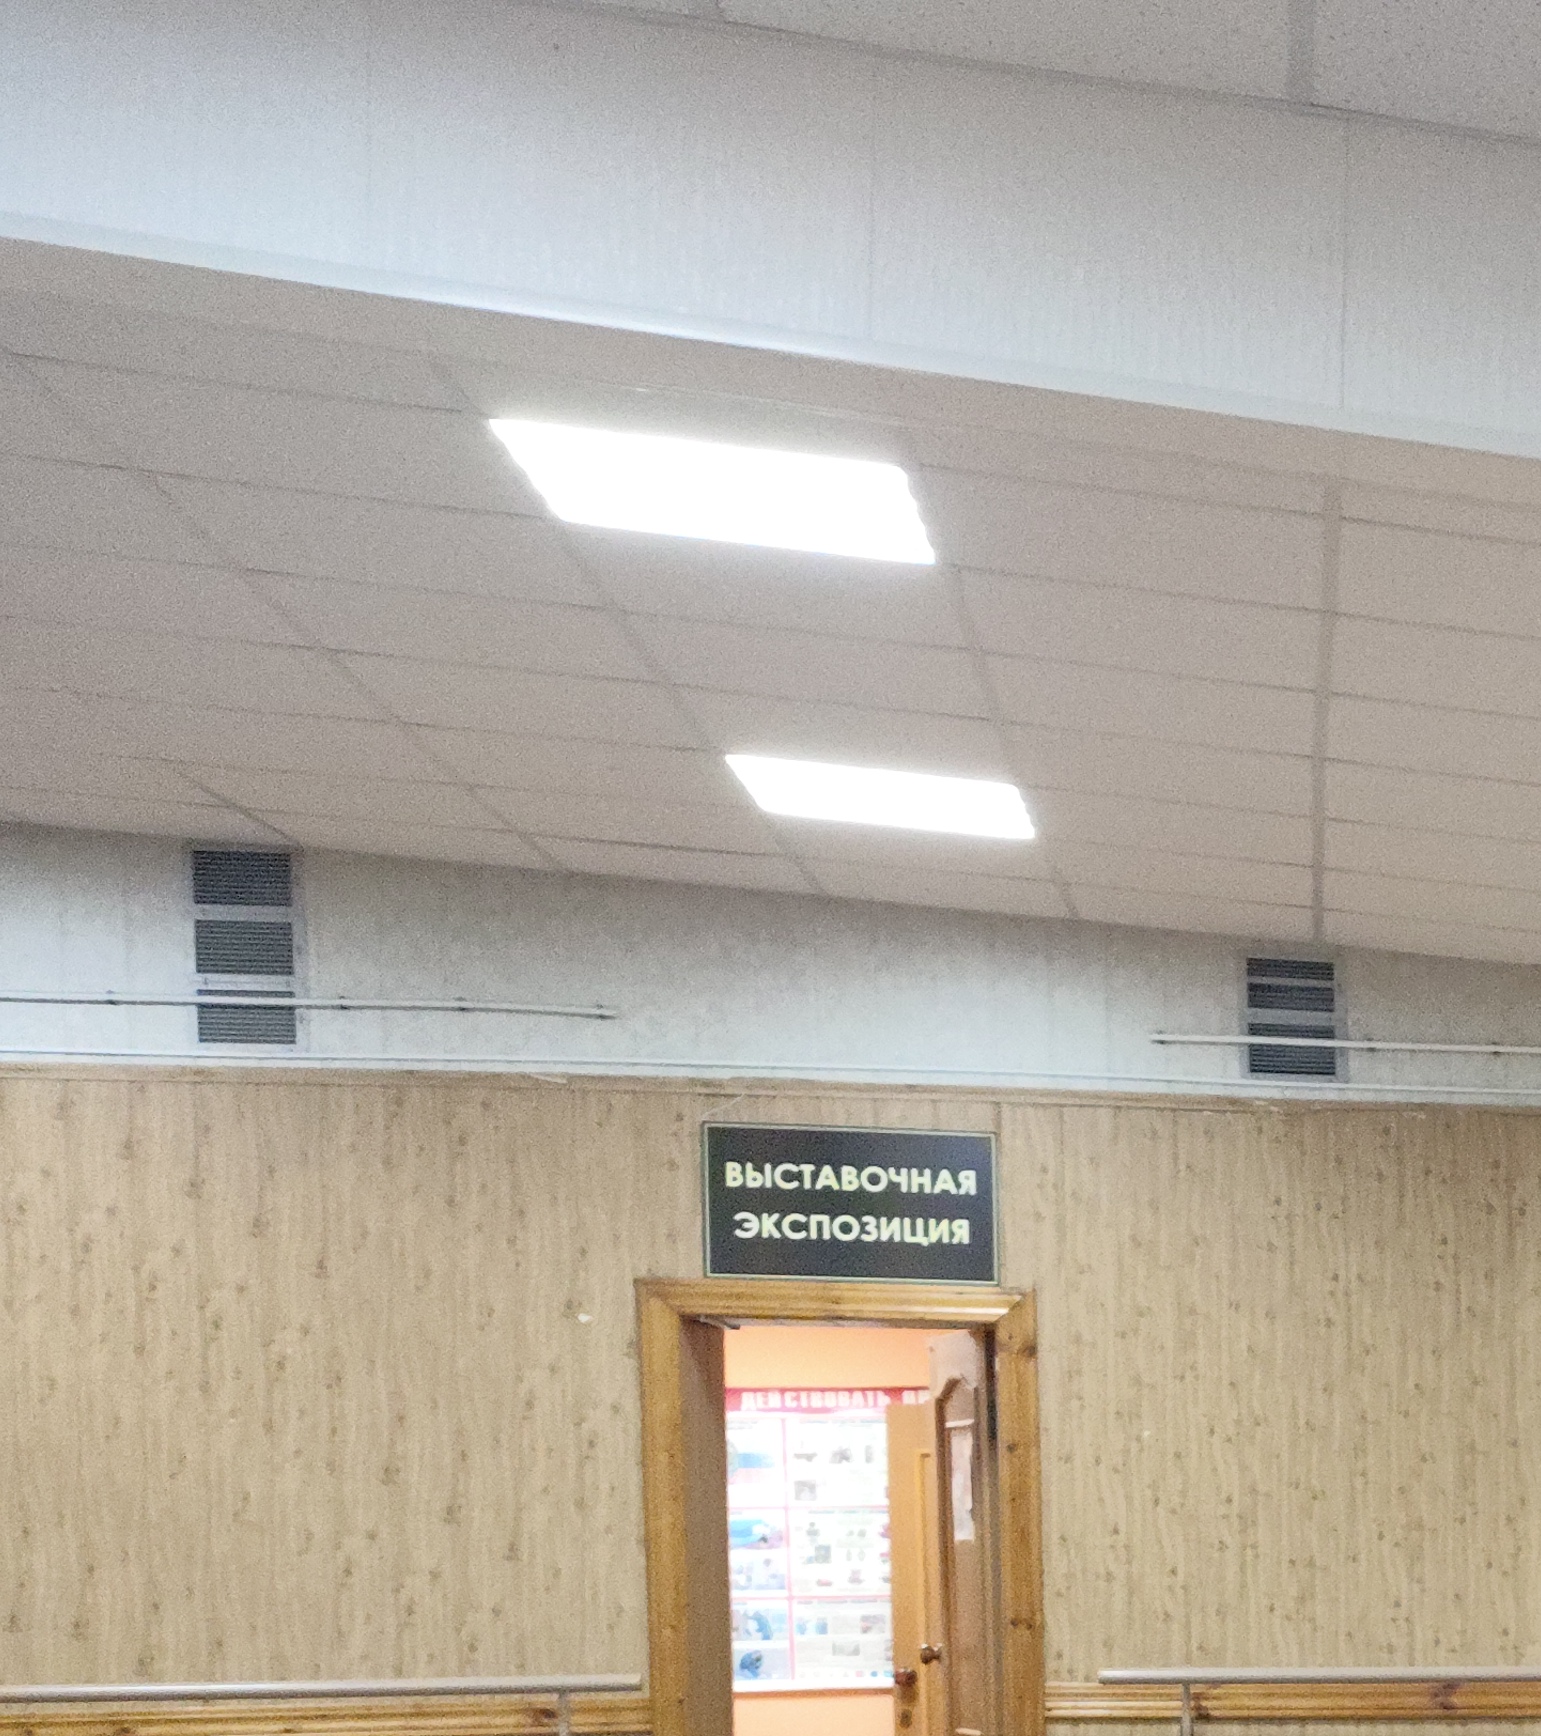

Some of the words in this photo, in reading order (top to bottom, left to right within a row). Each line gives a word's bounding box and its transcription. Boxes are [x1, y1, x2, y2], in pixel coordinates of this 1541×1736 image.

[724, 1161, 978, 1195] ВЫСТАВОЧНАЯ
[733, 1211, 971, 1246] ЭКСПОЗИЦИЯ
[741, 1390, 891, 1411] ДЕЙСТВОВАТЬ
